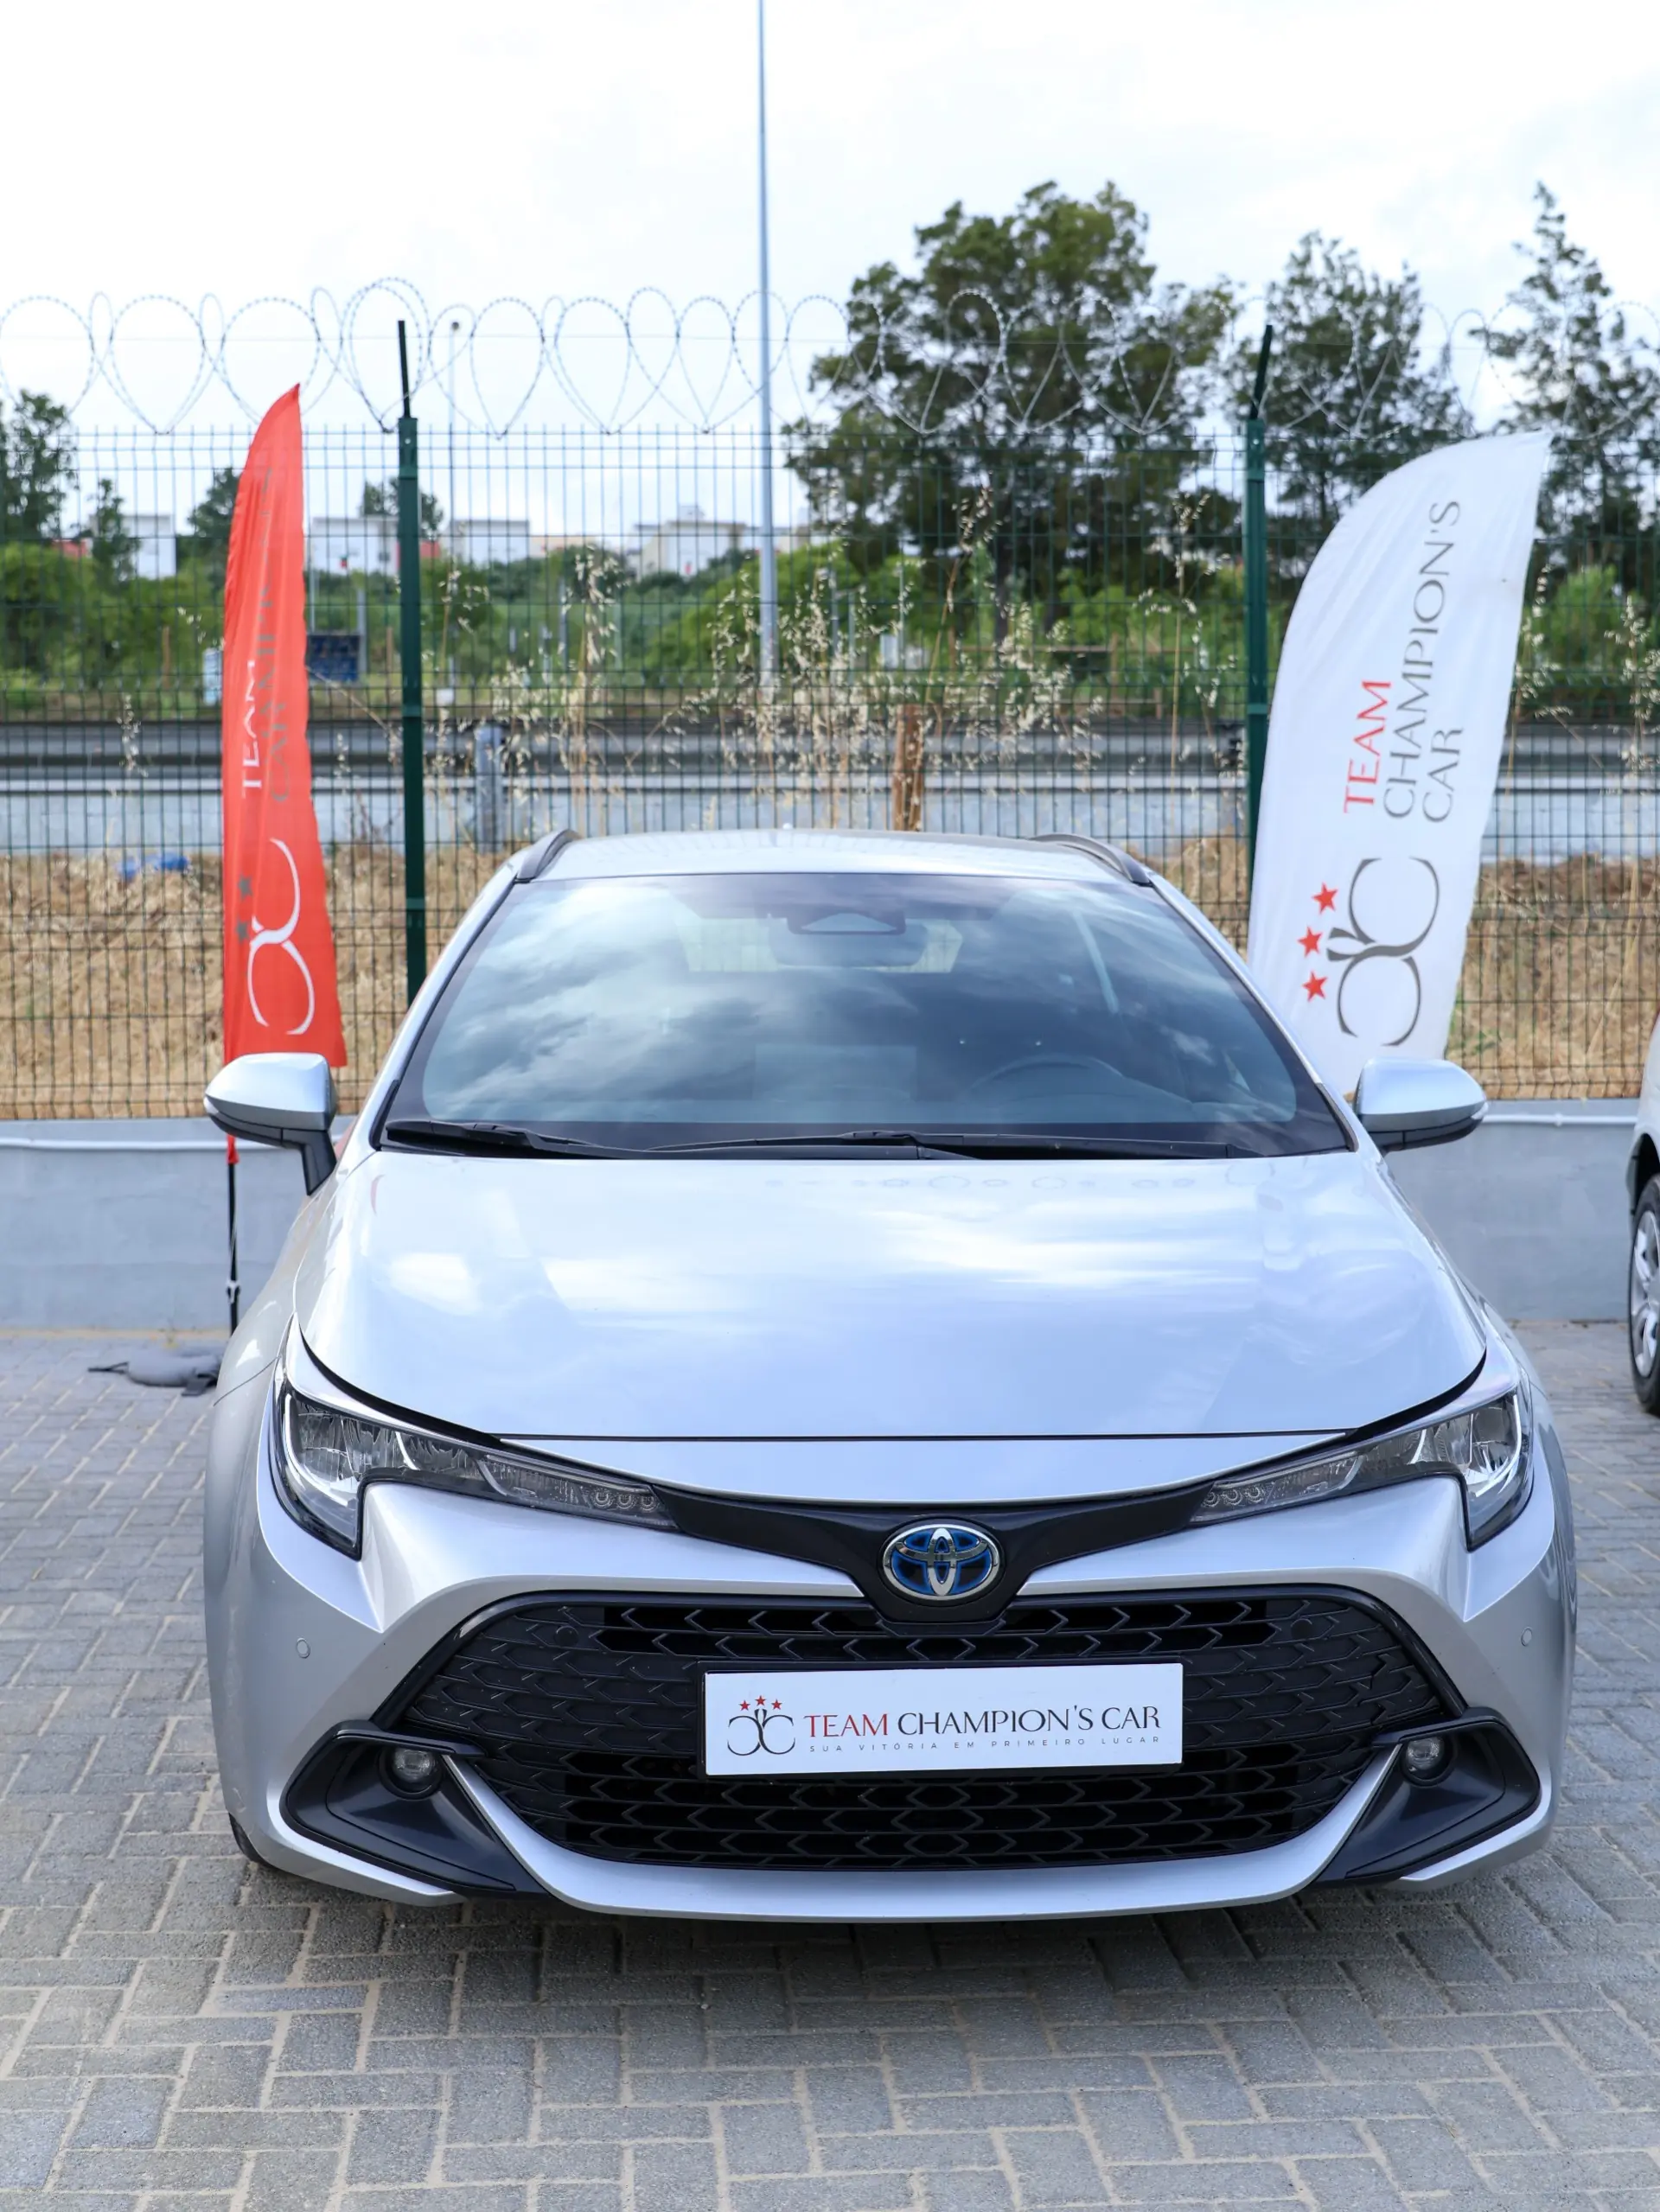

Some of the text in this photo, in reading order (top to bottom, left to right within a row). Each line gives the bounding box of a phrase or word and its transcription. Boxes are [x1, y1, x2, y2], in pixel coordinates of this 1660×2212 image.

[1383, 500, 1461, 819] CHAMPION'S
[242, 660, 263, 800] TEAM
[1344, 680, 1393, 814] TEAM
[1422, 728, 1464, 823] CAR
[802, 1705, 1162, 1737] TEAM CHAMPION'S CAR
[809, 1736, 1159, 1753] SUA VITÓRIA EM PRIMEIRO LUGAR
